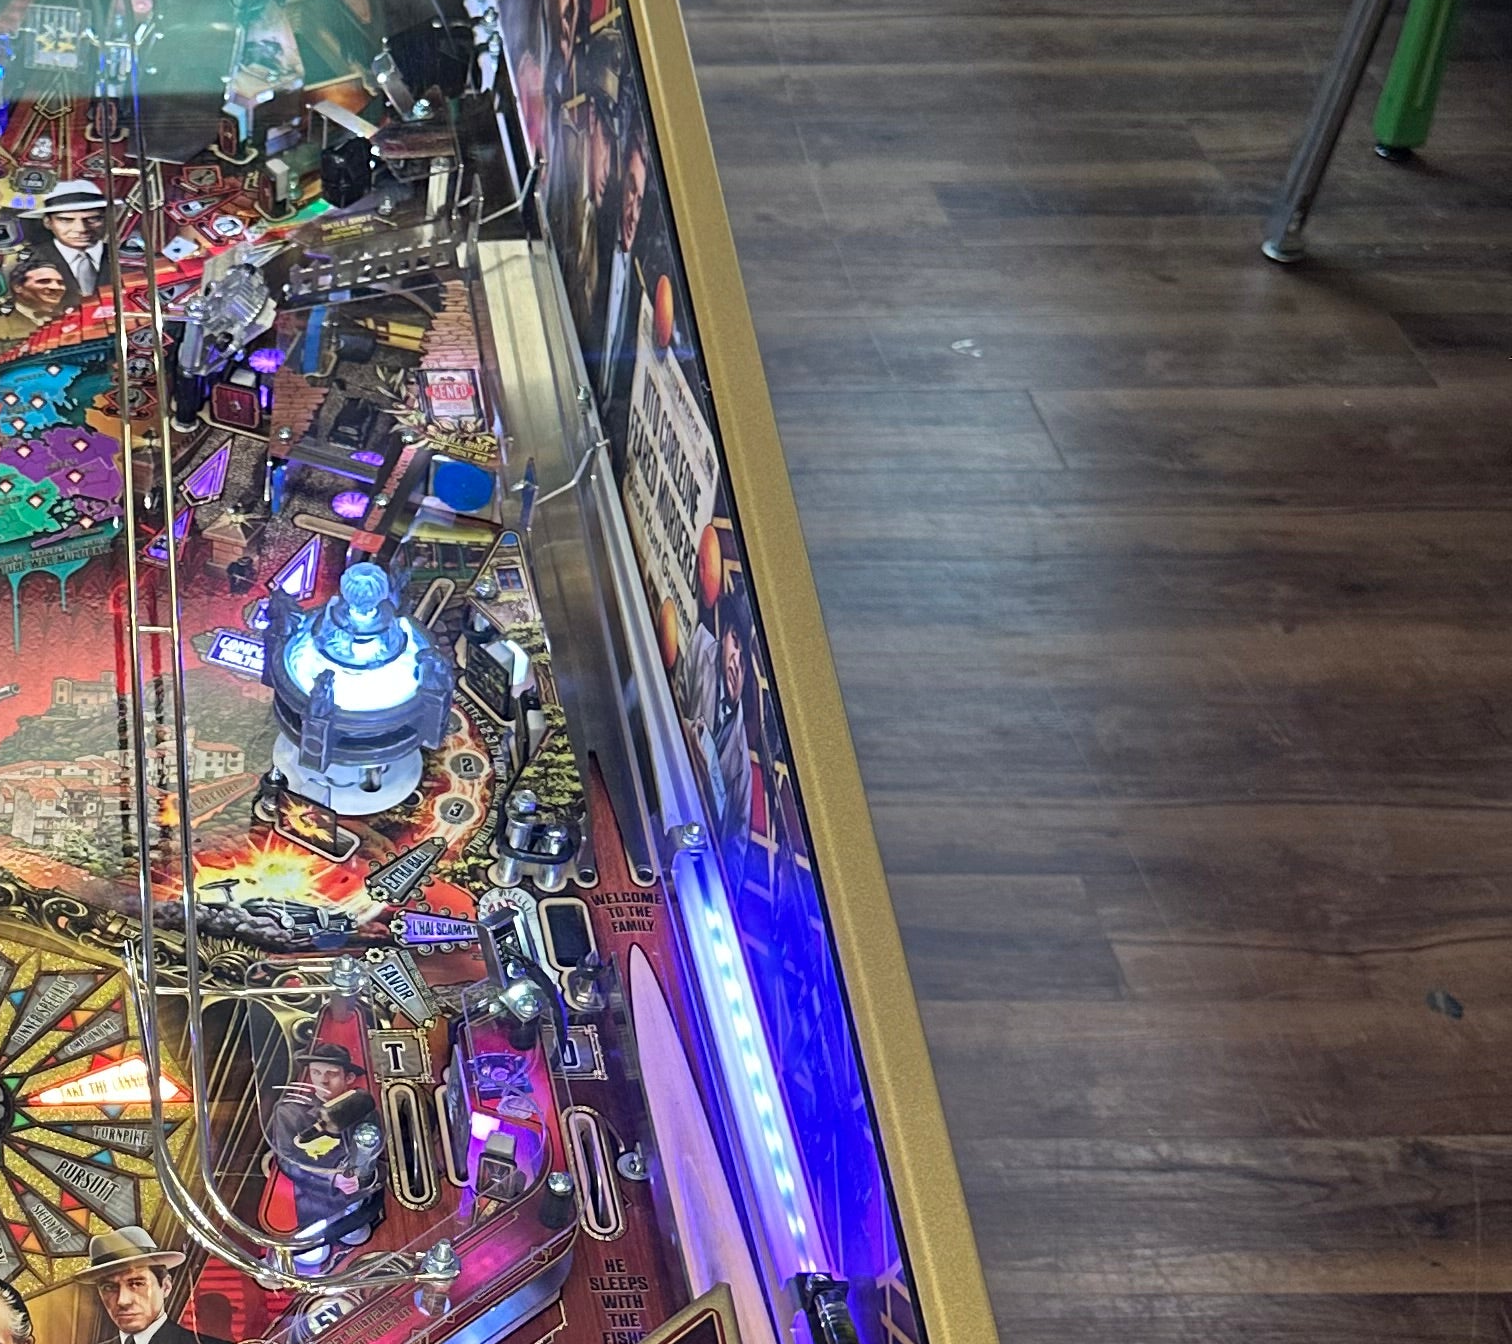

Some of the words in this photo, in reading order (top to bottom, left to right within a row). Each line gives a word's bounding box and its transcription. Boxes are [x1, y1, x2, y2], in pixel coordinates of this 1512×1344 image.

[432, 383, 468, 398] GENCO
[661, 551, 692, 638] Gunmen
[460, 757, 474, 774] 2
[449, 802, 465, 818] 3
[382, 866, 412, 892] EXTRA
[408, 849, 433, 873] BALL
[591, 892, 662, 905] WELCOME
[607, 908, 624, 918] TO
[627, 906, 652, 917] THE
[413, 920, 434, 935] L'HAI
[611, 920, 654, 933] FAMILY
[376, 963, 415, 1001] FAVOR
[11, 1013, 41, 1046] DINNER
[36, 975, 78, 1018] SPECIALS
[382, 1041, 405, 1072] T
[93, 1125, 147, 1146] TURNPIKE
[54, 1159, 120, 1203] PURSUIT
[604, 1258, 625, 1272] HE
[589, 1276, 648, 1290] SLEEPS
[601, 1294, 644, 1308] WITH
[608, 1313, 640, 1327] THE
